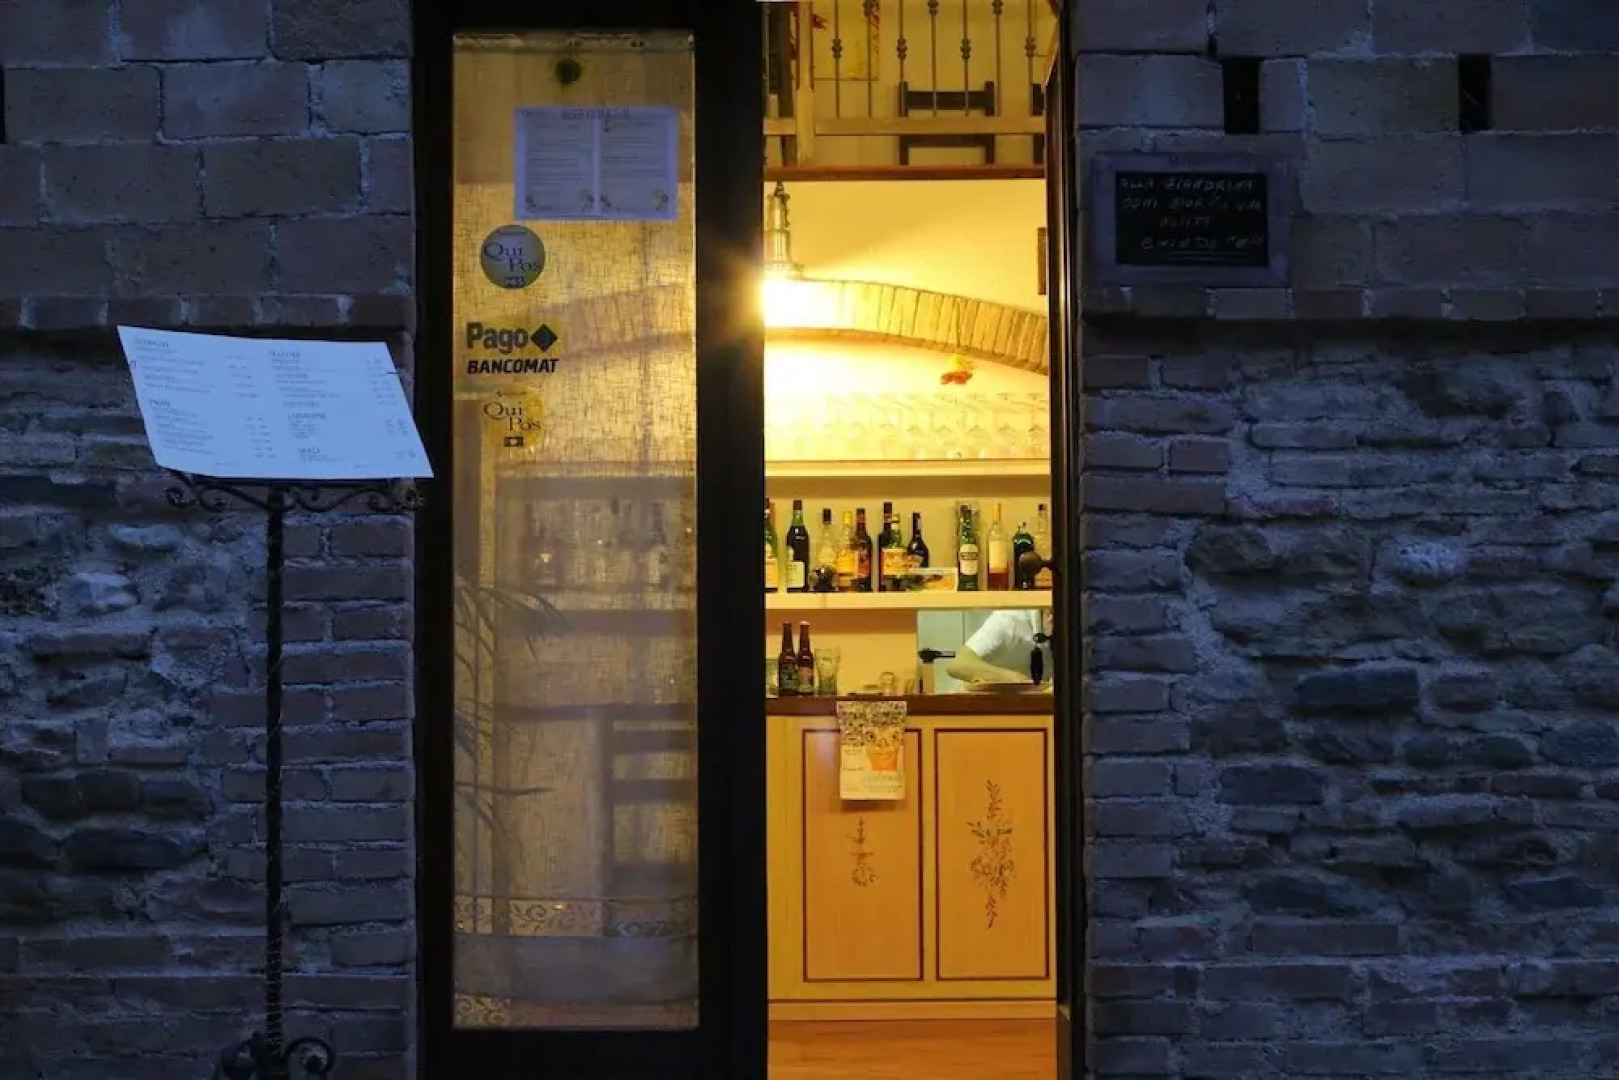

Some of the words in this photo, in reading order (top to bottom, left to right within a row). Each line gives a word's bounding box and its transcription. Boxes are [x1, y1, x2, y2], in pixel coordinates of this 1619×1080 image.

[483, 241, 523, 262] Qui
[466, 321, 529, 354] Pago
[467, 358, 559, 375] BANCOMAT
[483, 401, 523, 421] Qui
[508, 417, 542, 431] Pos
